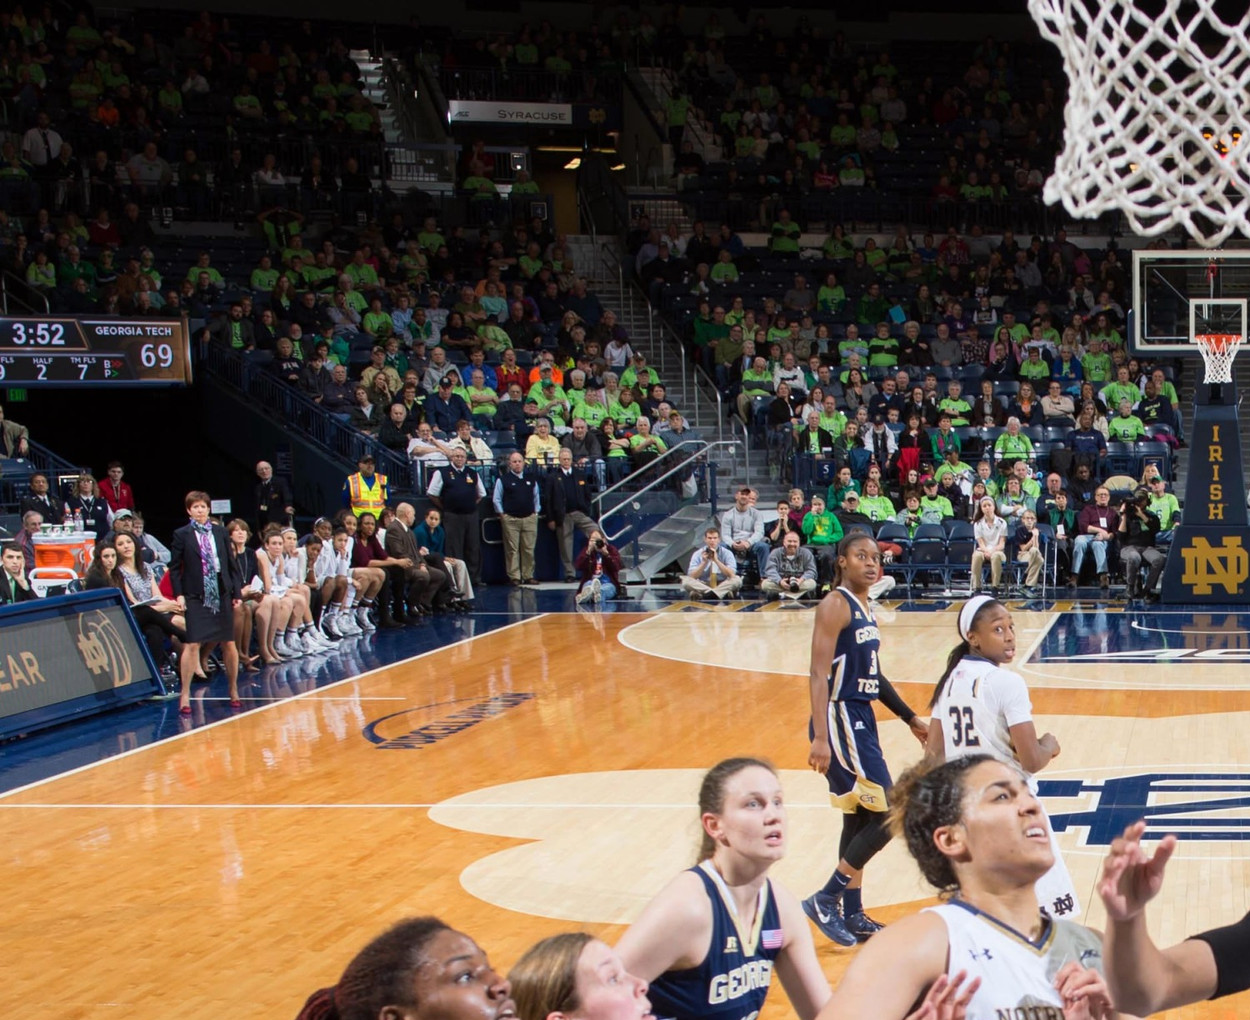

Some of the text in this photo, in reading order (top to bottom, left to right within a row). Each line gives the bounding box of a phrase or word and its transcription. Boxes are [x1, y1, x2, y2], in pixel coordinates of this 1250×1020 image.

[498, 110, 566, 121] SYRACUSE
[12, 323, 66, 345] 3:52
[95, 326, 172, 337] GEORGIA TECH
[33, 357, 53, 365] HALF
[141, 344, 173, 368] 69
[36, 364, 48, 380] 2
[77, 364, 88, 380] 7
[104, 360, 111, 369] B
[104, 370, 111, 378] P
[1122, 429, 1129, 438] 6
[823, 465, 830, 474] 5
[1208, 425, 1224, 520] IRISH
[858, 678, 880, 694] TEC
[948, 706, 982, 747] 32
[708, 959, 774, 1004] GEORG
